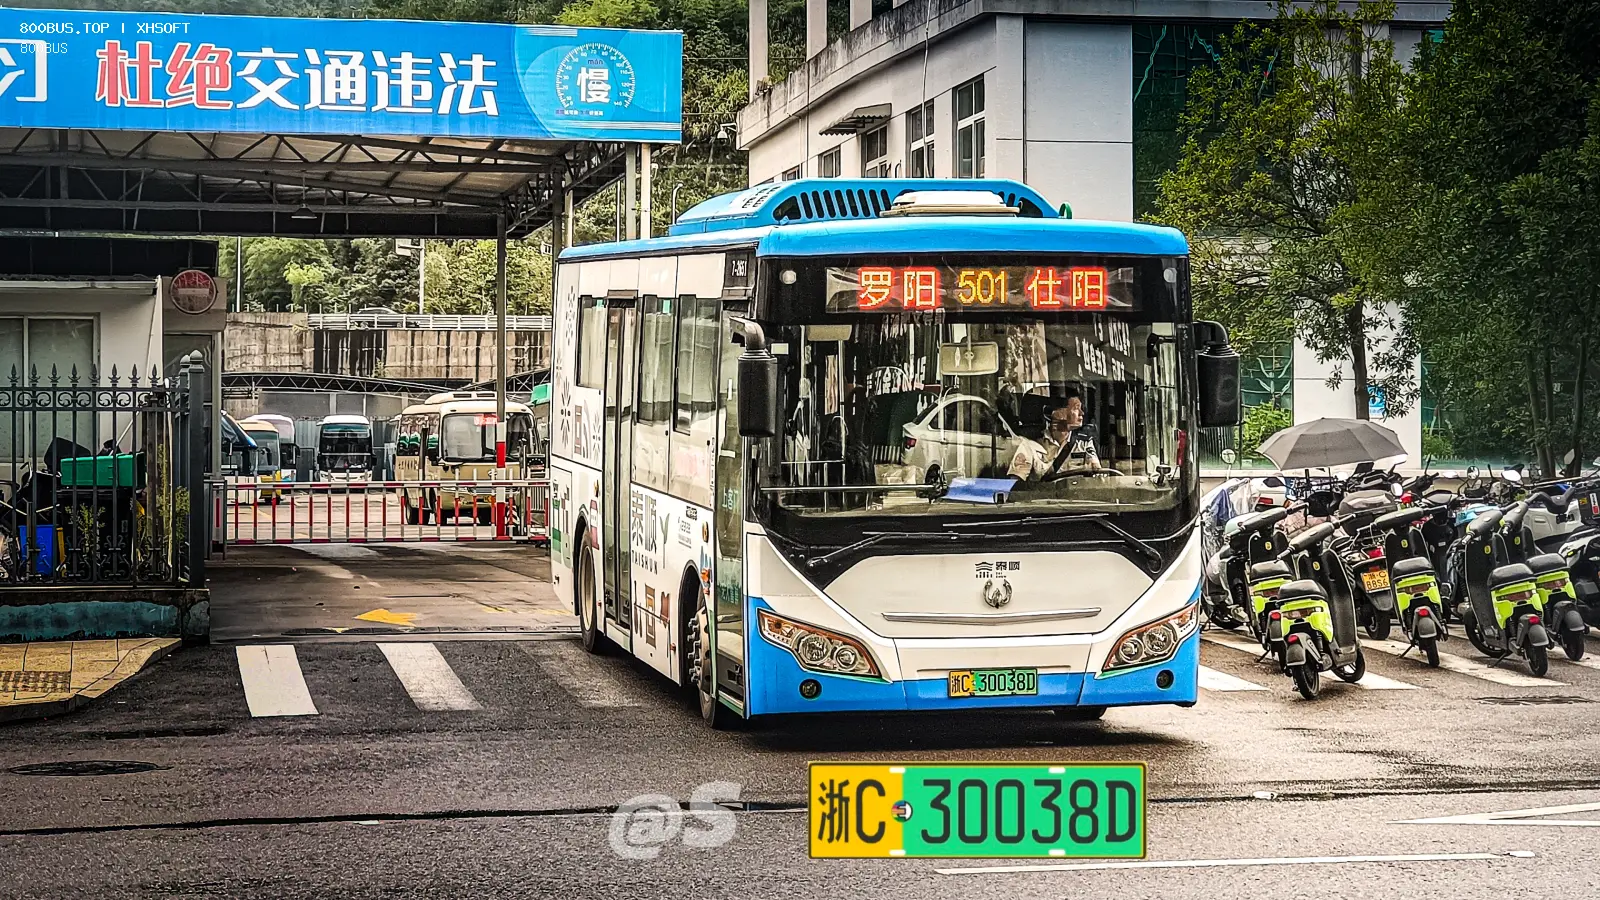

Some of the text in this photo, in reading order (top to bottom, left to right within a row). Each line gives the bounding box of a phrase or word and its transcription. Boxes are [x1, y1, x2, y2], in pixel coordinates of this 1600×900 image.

[95, 39, 500, 117] 杜绝交通违法
[576, 66, 611, 104] 慢
[858, 268, 1105, 308] 罗阳 501 仕阳
[631, 489, 658, 555] 泰顺
[631, 549, 658, 575] TAISHUN
